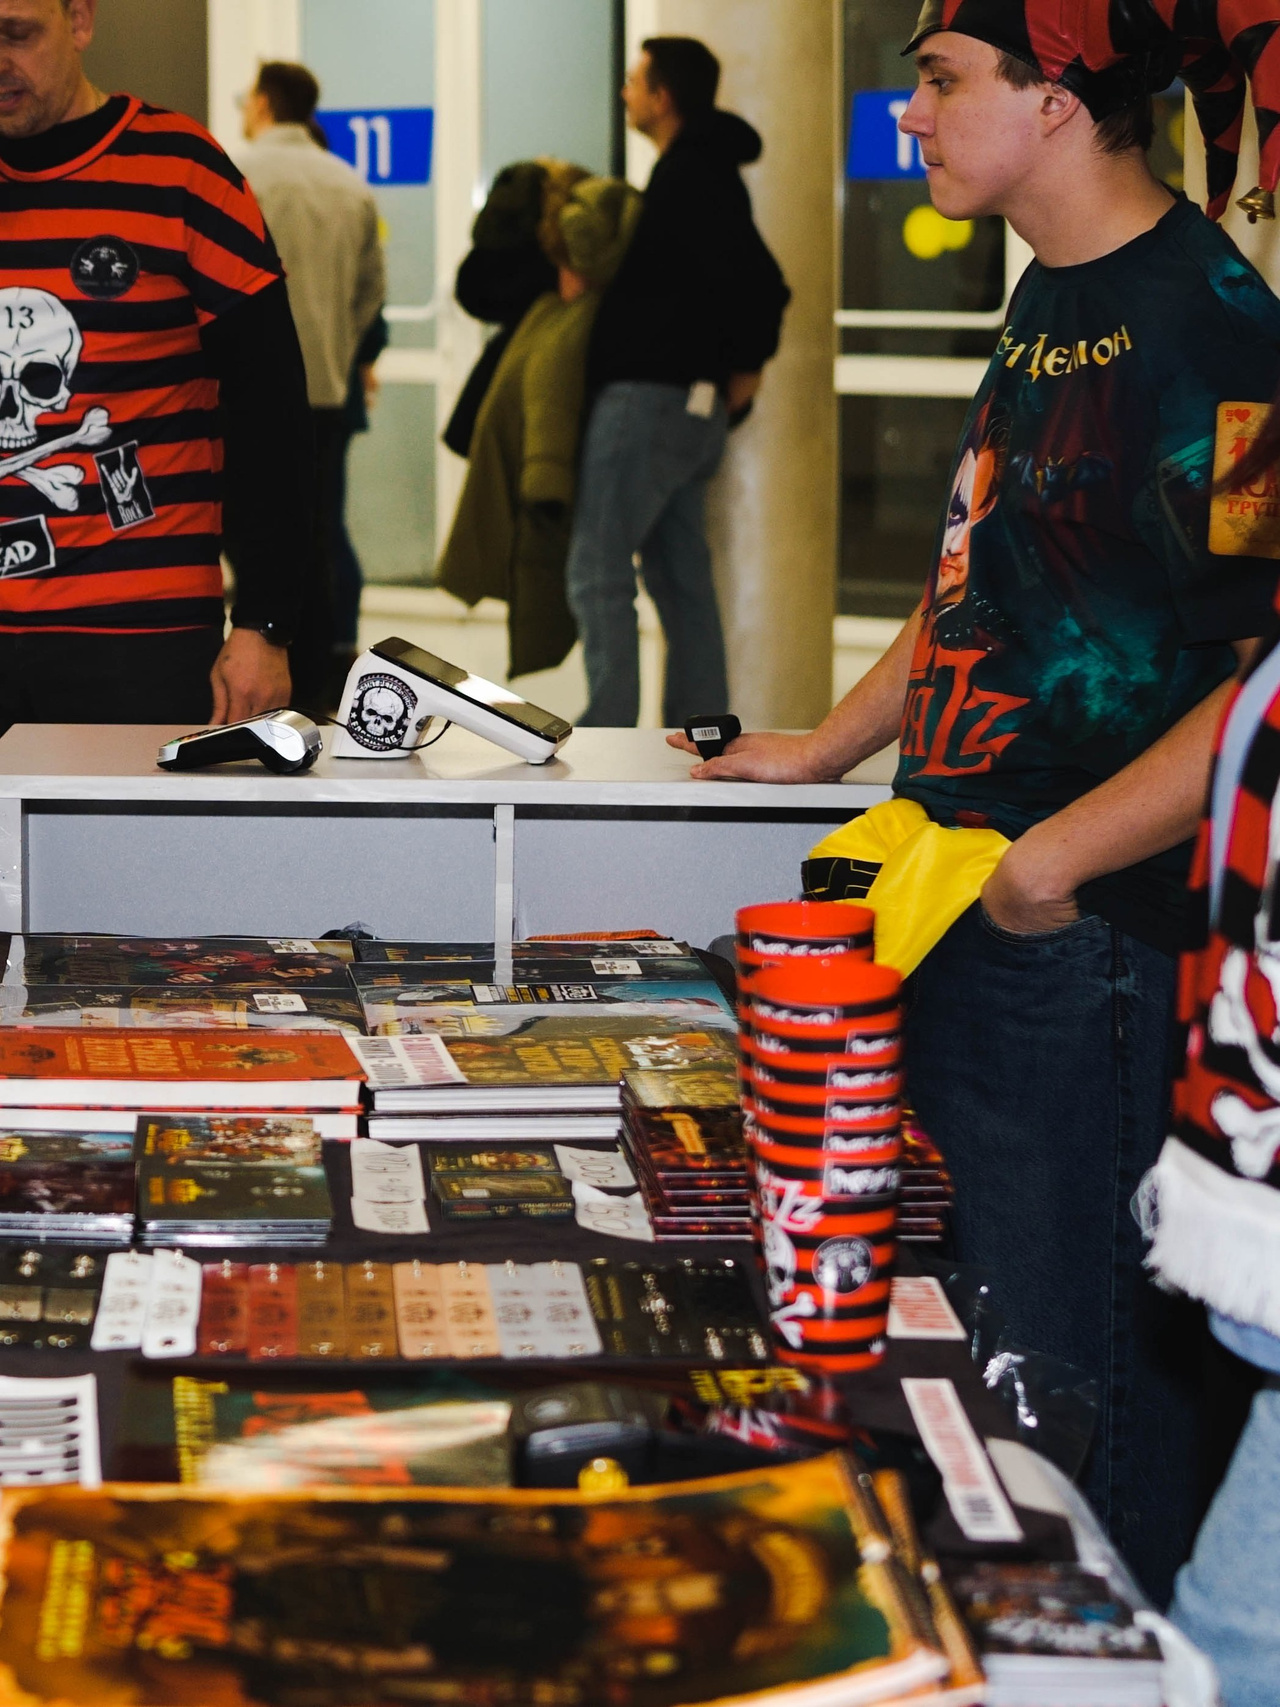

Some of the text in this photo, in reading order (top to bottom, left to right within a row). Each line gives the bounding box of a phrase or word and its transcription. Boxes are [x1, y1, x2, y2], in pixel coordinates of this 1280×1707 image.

[350, 117, 394, 178] 11
[888, 99, 928, 171] 1
[4, 304, 35, 330] 13
